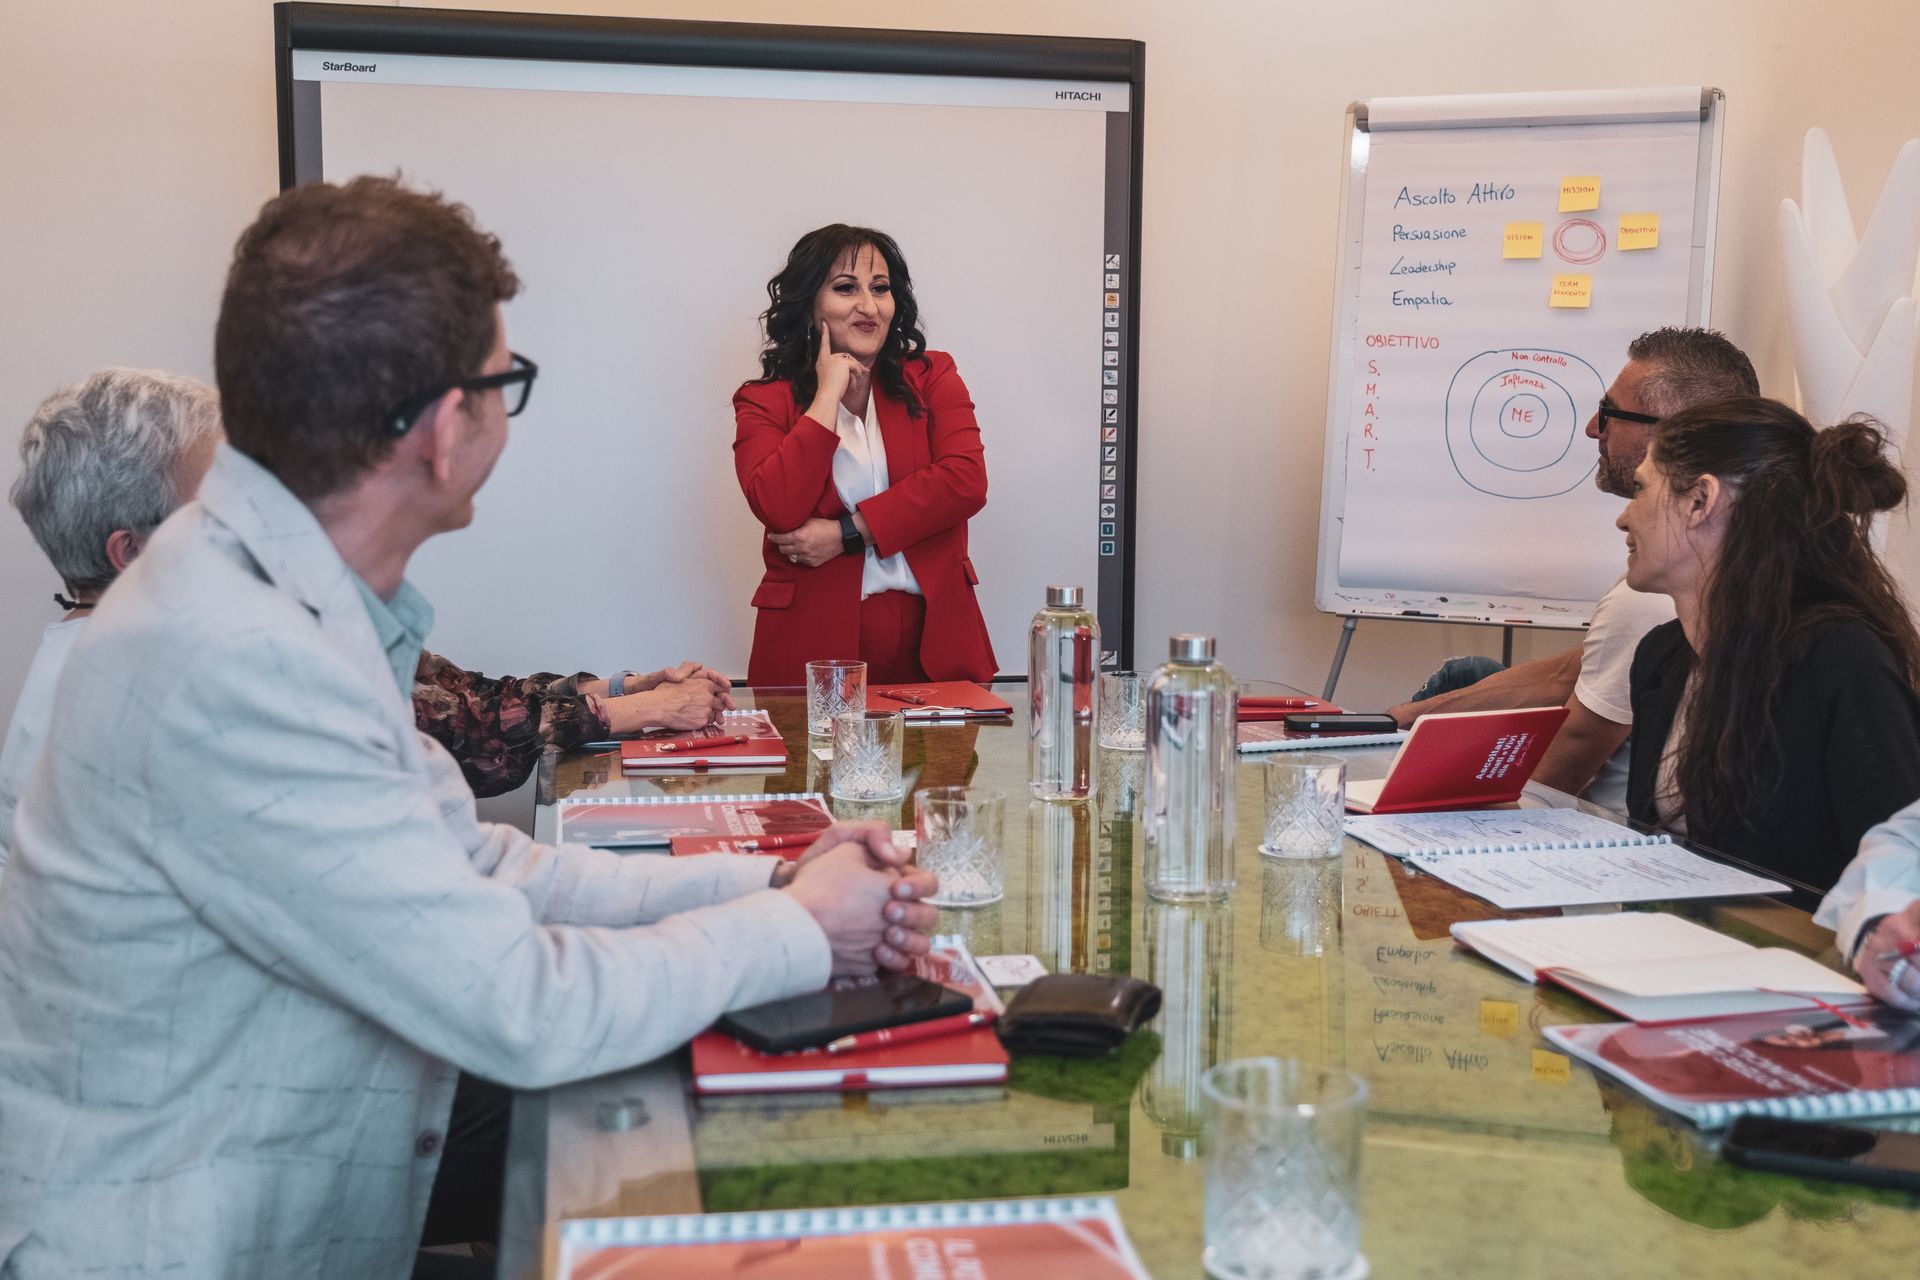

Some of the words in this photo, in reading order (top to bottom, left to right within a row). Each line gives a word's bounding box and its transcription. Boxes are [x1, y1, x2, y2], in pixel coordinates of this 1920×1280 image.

[322, 61, 376, 73] StarBoard
[1055, 91, 1101, 101] HITACHI
[1393, 186, 1456, 209] Ascolto
[1562, 186, 1595, 194] MISSION
[1393, 224, 1467, 242] Persuasione
[1390, 256, 1457, 276] Leadership
[1559, 280, 1579, 288] TEAM
[1392, 289, 1454, 310] Empatia
[1365, 334, 1440, 350] OBIETTIVO
[1511, 352, 1529, 361] Non
[1532, 353, 1567, 367] Controllo
[1500, 374, 1546, 390] Influenza
[1512, 407, 1536, 423] ME
